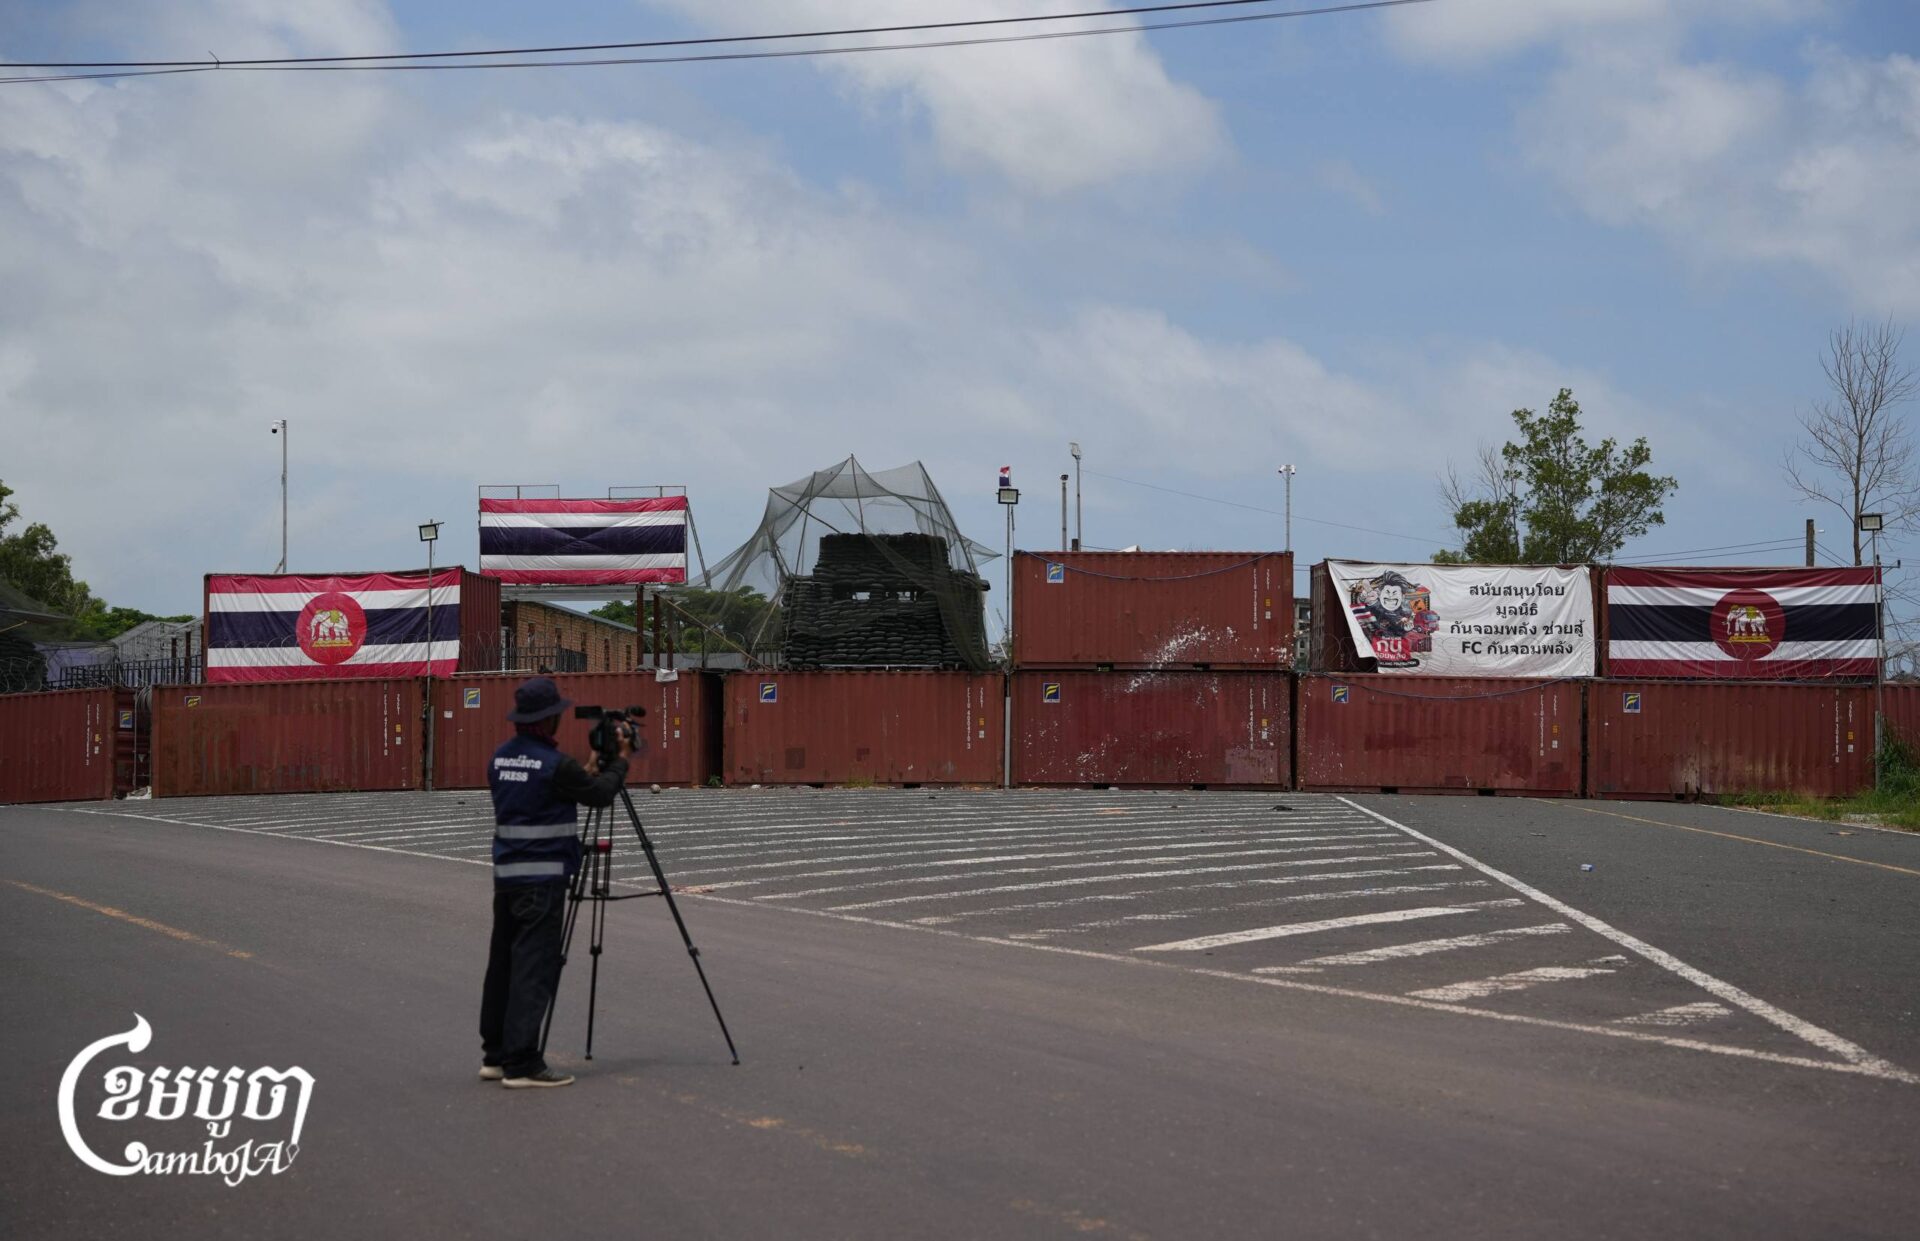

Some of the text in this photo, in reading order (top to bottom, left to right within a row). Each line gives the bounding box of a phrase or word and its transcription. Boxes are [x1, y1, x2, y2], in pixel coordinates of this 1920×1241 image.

[1469, 582, 1565, 599] สนับสนุนโดย
[1496, 602, 1539, 619] มูลนิธิ
[1450, 619, 1586, 637] กันจอมพลัง ช่วยสู้
[1461, 640, 1574, 655] FC กันจอมพลัง
[499, 770, 529, 782] PRESS
